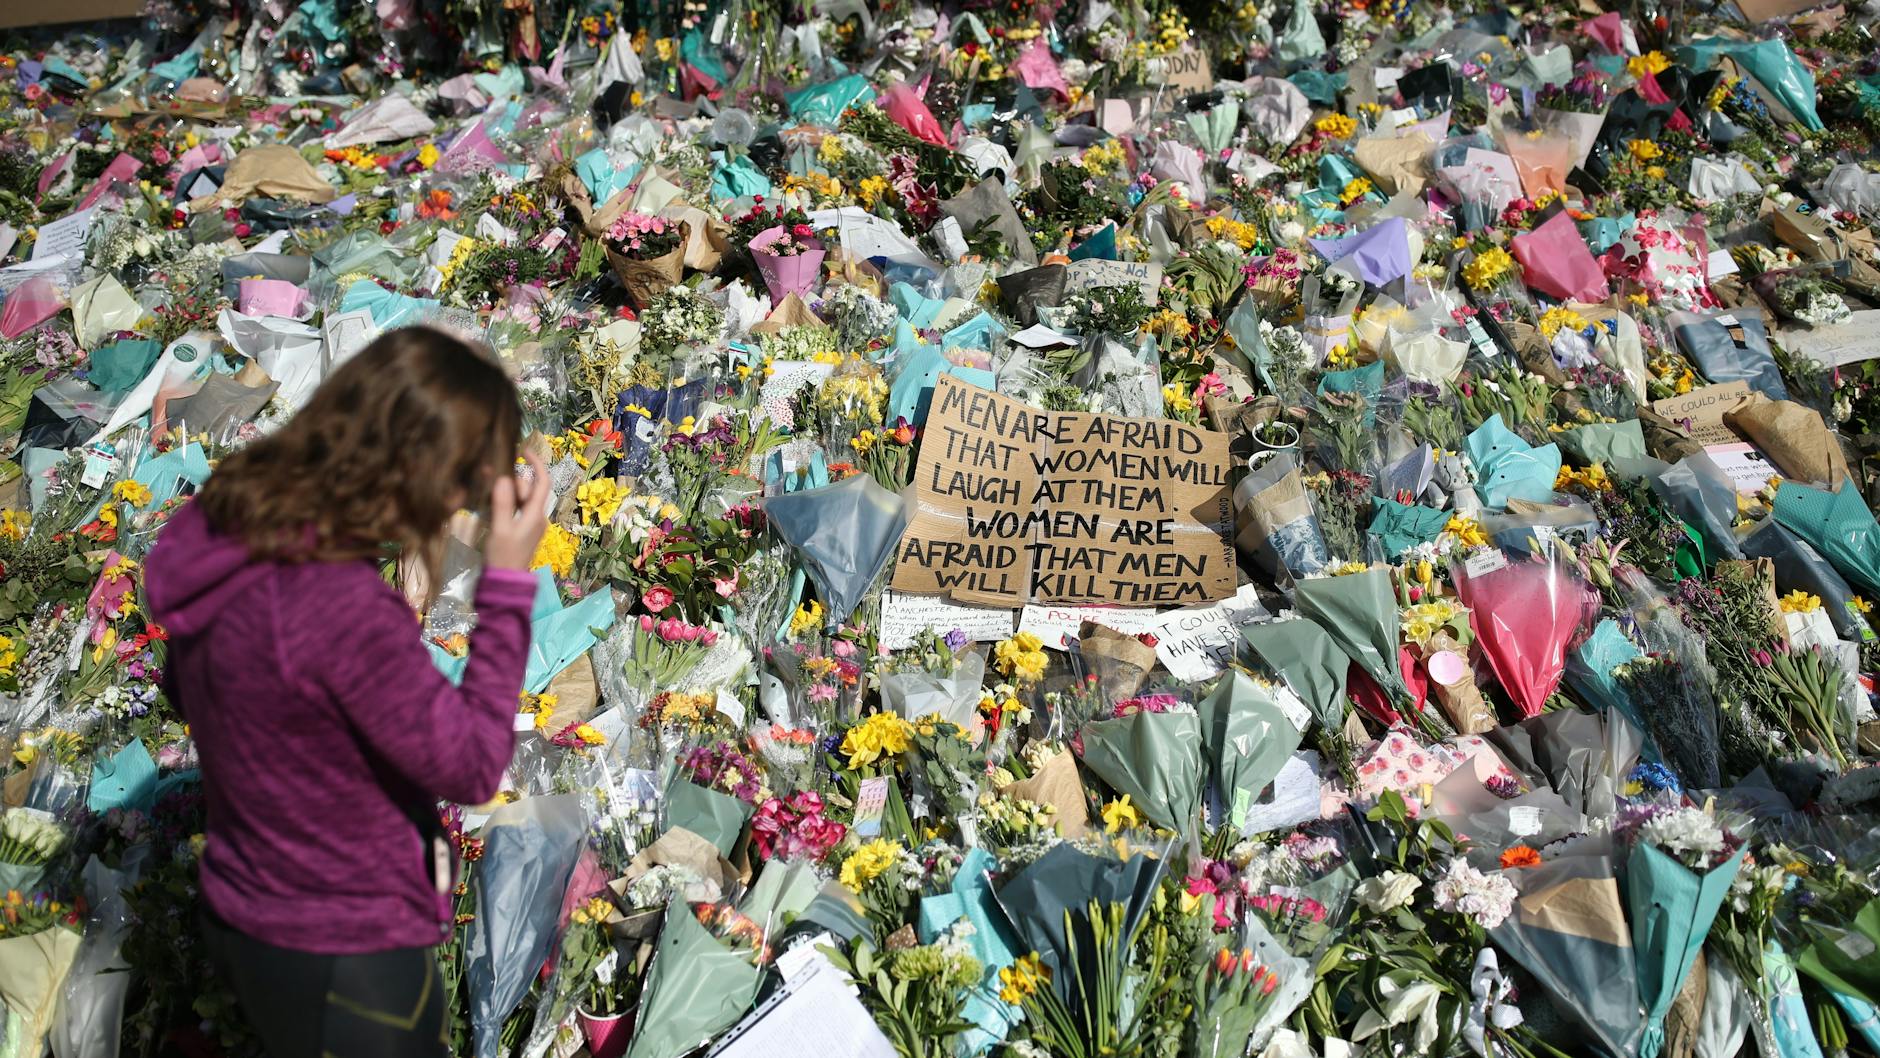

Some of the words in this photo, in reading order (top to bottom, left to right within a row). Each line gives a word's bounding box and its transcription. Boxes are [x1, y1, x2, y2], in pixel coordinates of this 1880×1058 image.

[1659, 405, 1675, 417] WE
[1681, 396, 1715, 413] COULD
[1718, 392, 1732, 402] ALL
[1009, 410, 1078, 444] ARE
[1082, 416, 1203, 454] AFRAID
[943, 425, 1020, 471] THAT
[1029, 448, 1159, 480] WOMEN
[1163, 456, 1228, 486] WILL
[1751, 463, 1770, 471] whe
[931, 462, 1021, 505] LAUGH
[1031, 479, 1077, 504] AT
[1081, 479, 1179, 513] THEM.
[1219, 497, 1230, 524] ATWOOD
[966, 506, 1100, 540] WOMEN
[1110, 518, 1175, 546] ARE
[901, 537, 1017, 569] AFRAID
[1024, 542, 1116, 574] THAT
[1117, 552, 1207, 577] MEN
[934, 570, 1017, 595] WILL
[1030, 572, 1105, 598] KILL
[887, 605, 952, 615] MANCHESTER
[1048, 610, 1100, 622] POLICE
[1109, 619, 1145, 630] sexually
[1153, 623, 1173, 641] IT
[1180, 607, 1235, 631] COULD
[1166, 633, 1215, 658] HAVE
[1200, 645, 1230, 669] ME
